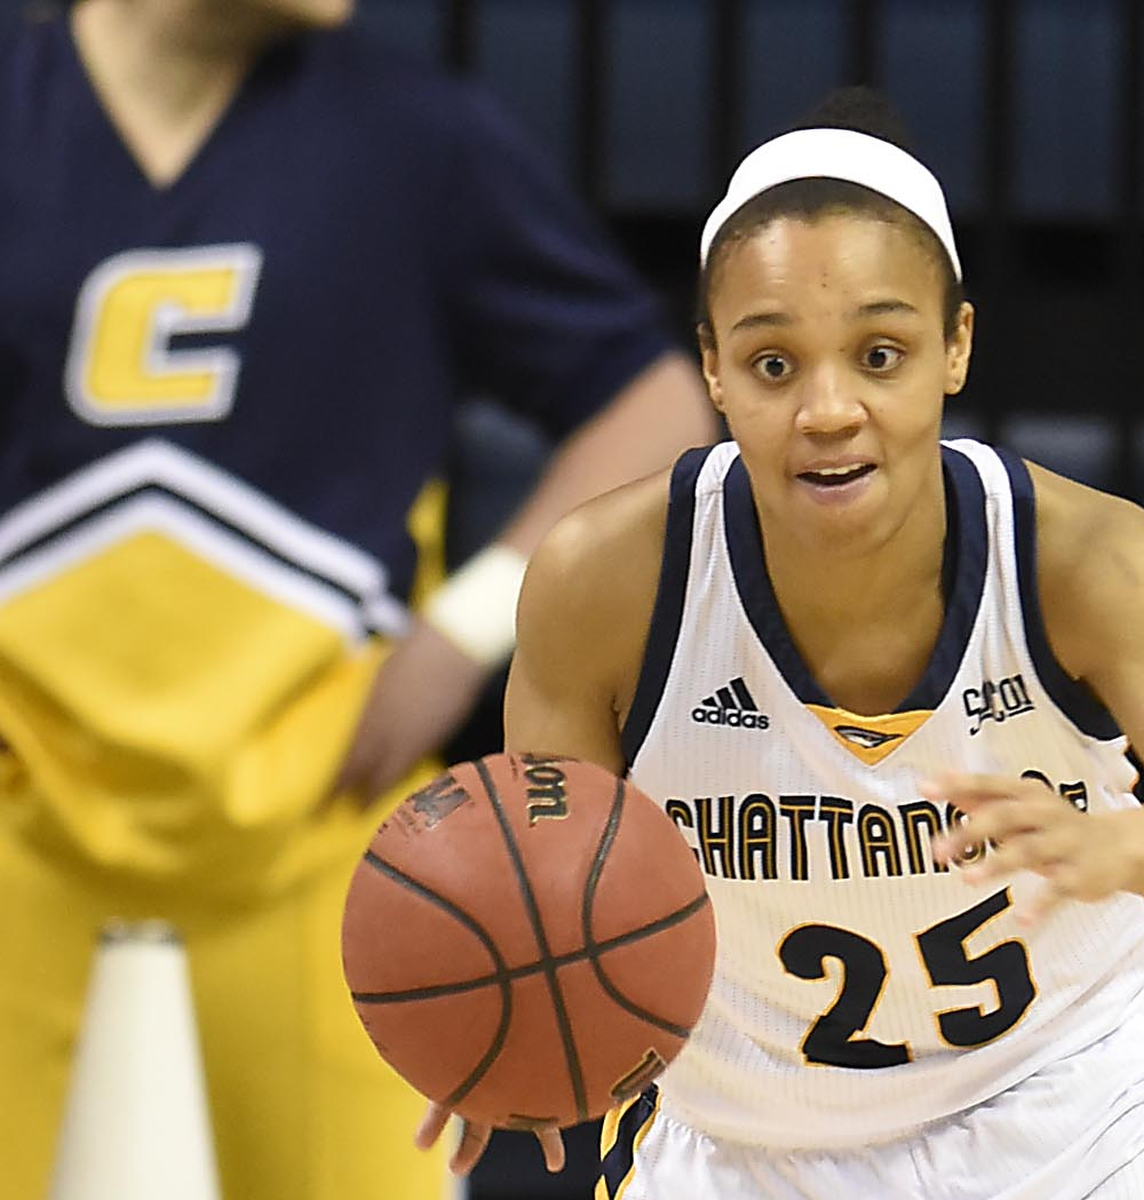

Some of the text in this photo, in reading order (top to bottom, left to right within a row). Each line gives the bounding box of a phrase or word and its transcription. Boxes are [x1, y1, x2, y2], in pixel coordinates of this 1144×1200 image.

[62, 242, 264, 429] C
[691, 707, 770, 730] adidas
[776, 884, 1040, 1069] 25
